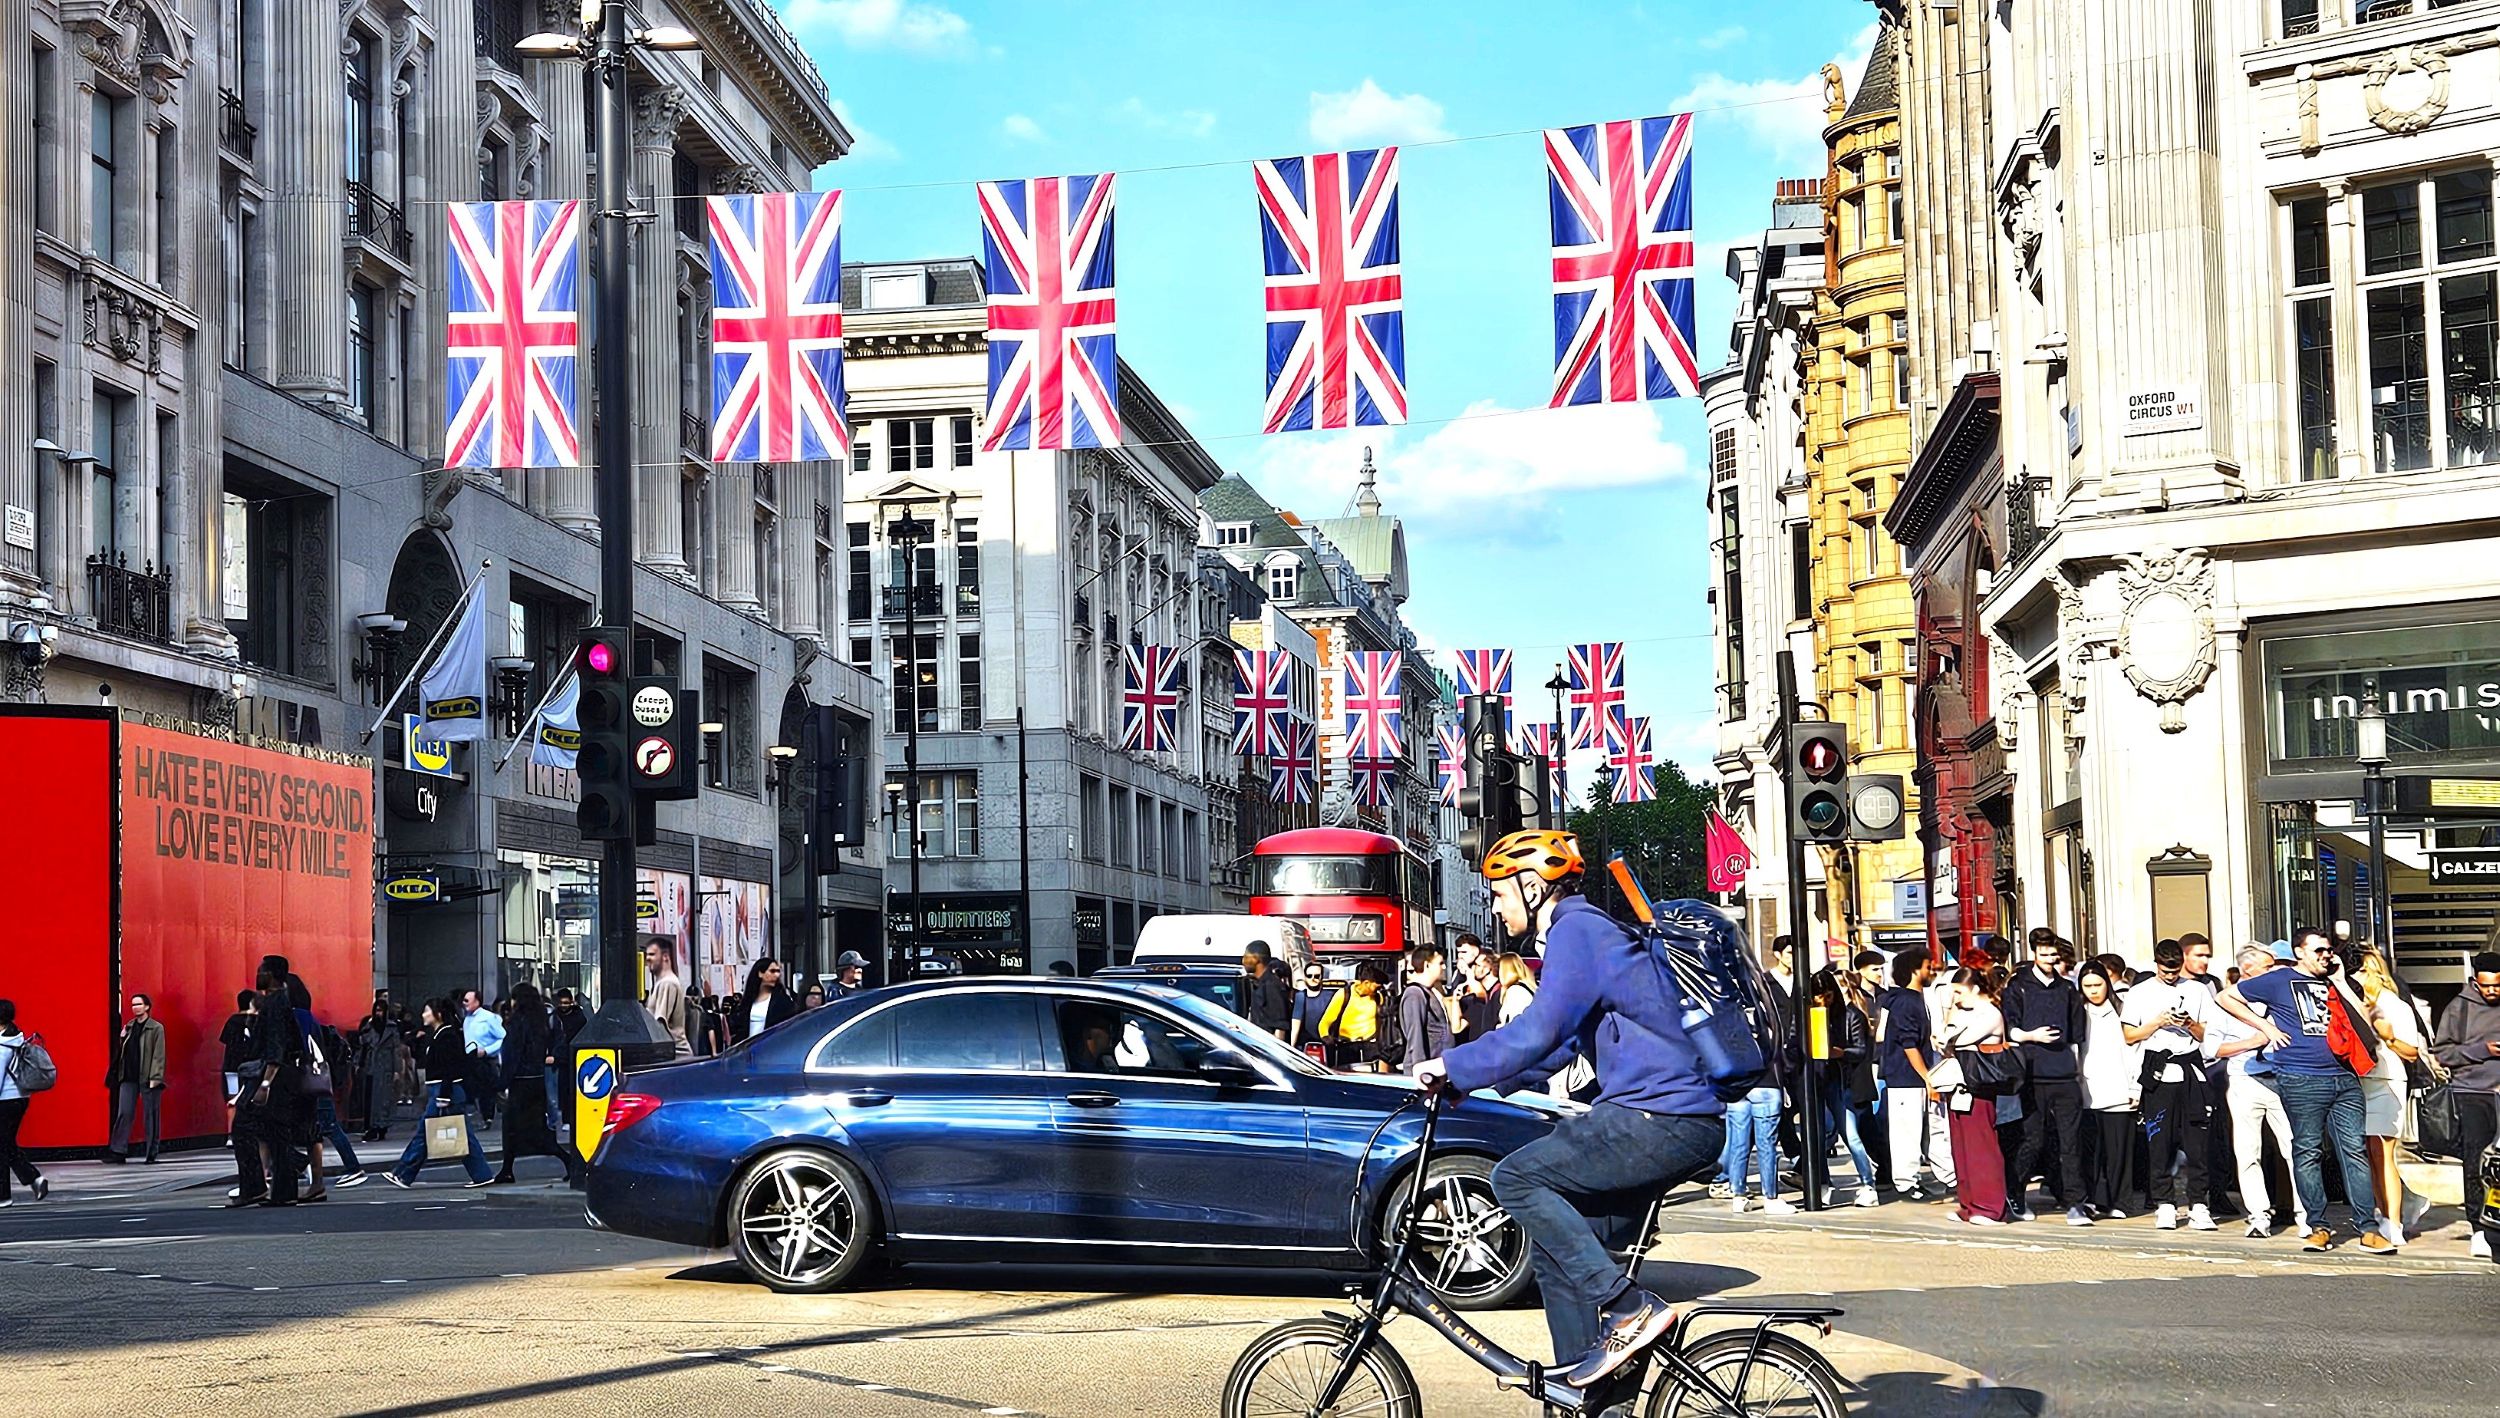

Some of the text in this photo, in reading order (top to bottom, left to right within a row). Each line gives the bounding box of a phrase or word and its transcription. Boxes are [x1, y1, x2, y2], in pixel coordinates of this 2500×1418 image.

[2129, 391, 2175, 407] OXFORD
[2129, 403, 2194, 420] CIRCUS W1
[236, 695, 322, 746] IKEA
[136, 745, 367, 834] HATE EVERY SECOND.
[417, 787, 438, 822] City
[156, 805, 351, 879] LOVE EVERY MILE.
[2441, 861, 2500, 875] CALZE
[389, 882, 432, 895] IKEA
[927, 911, 1011, 929] OUTFITTERS
[1350, 920, 1376, 938] 73
